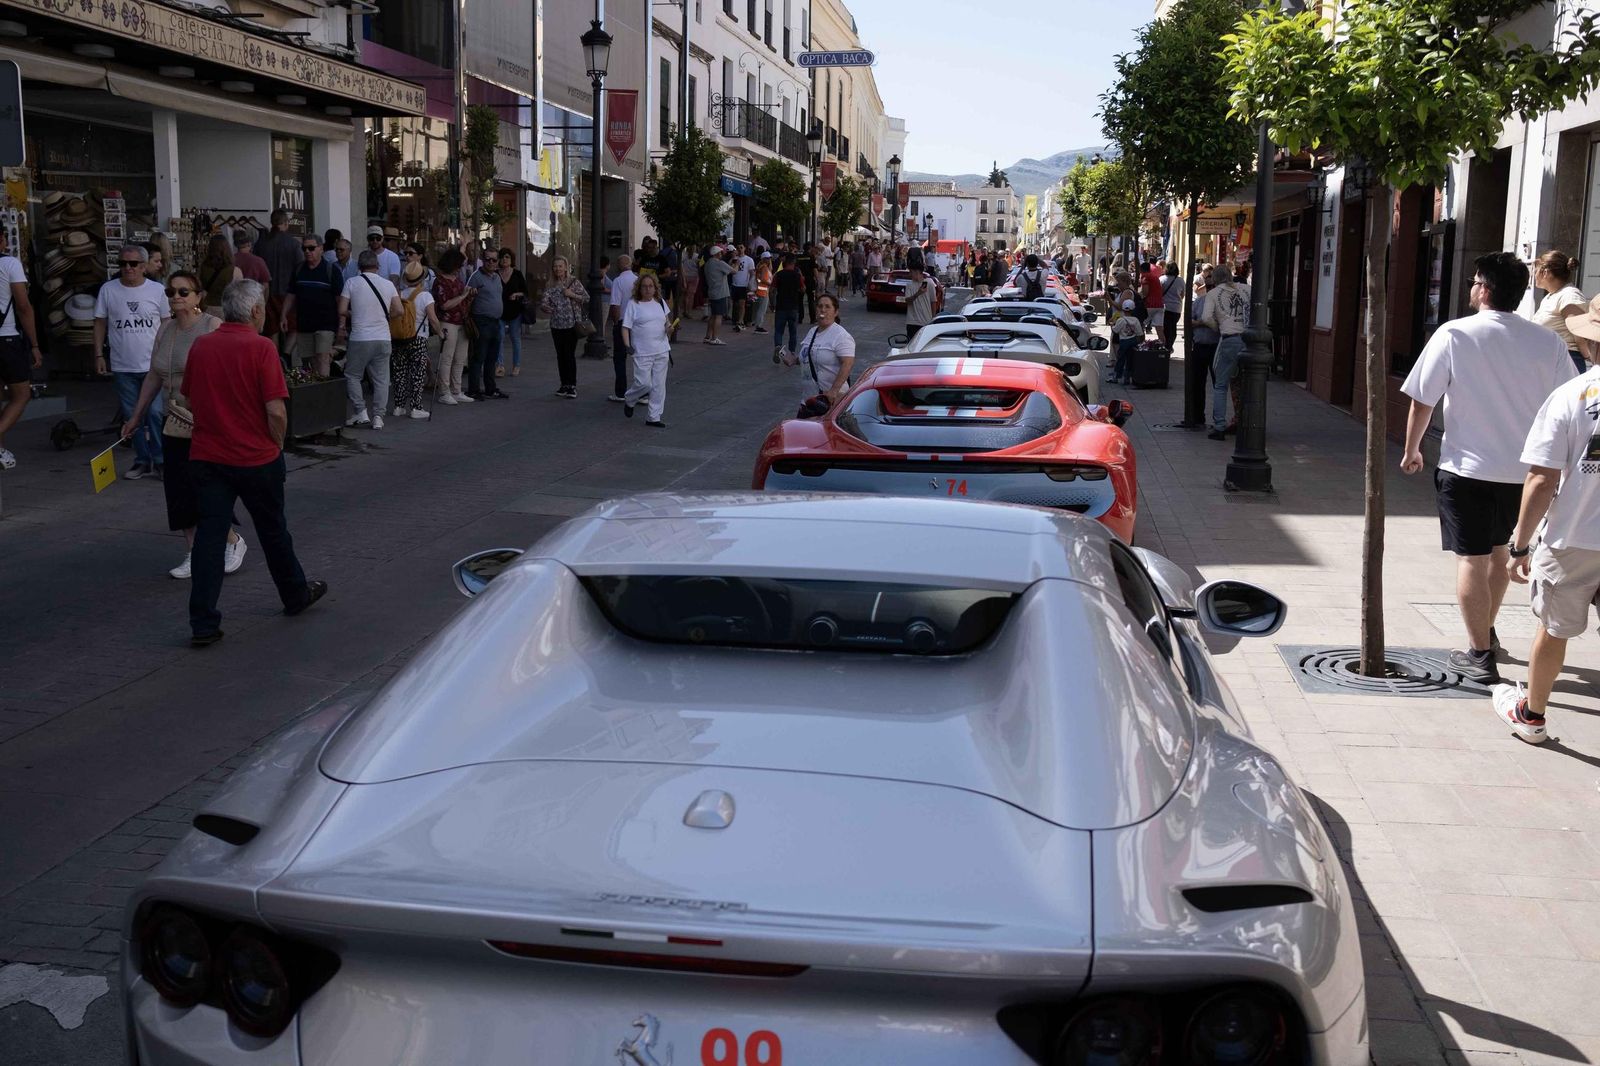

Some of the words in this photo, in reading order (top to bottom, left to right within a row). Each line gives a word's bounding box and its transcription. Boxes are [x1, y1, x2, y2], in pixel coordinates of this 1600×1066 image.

[146, 21, 245, 66] MAESTRANZA
[801, 54, 838, 65] OPTICA
[842, 53, 869, 64] BACA
[279, 188, 304, 211] ATM
[116, 319, 153, 329] ZAMU
[945, 478, 968, 496] 74
